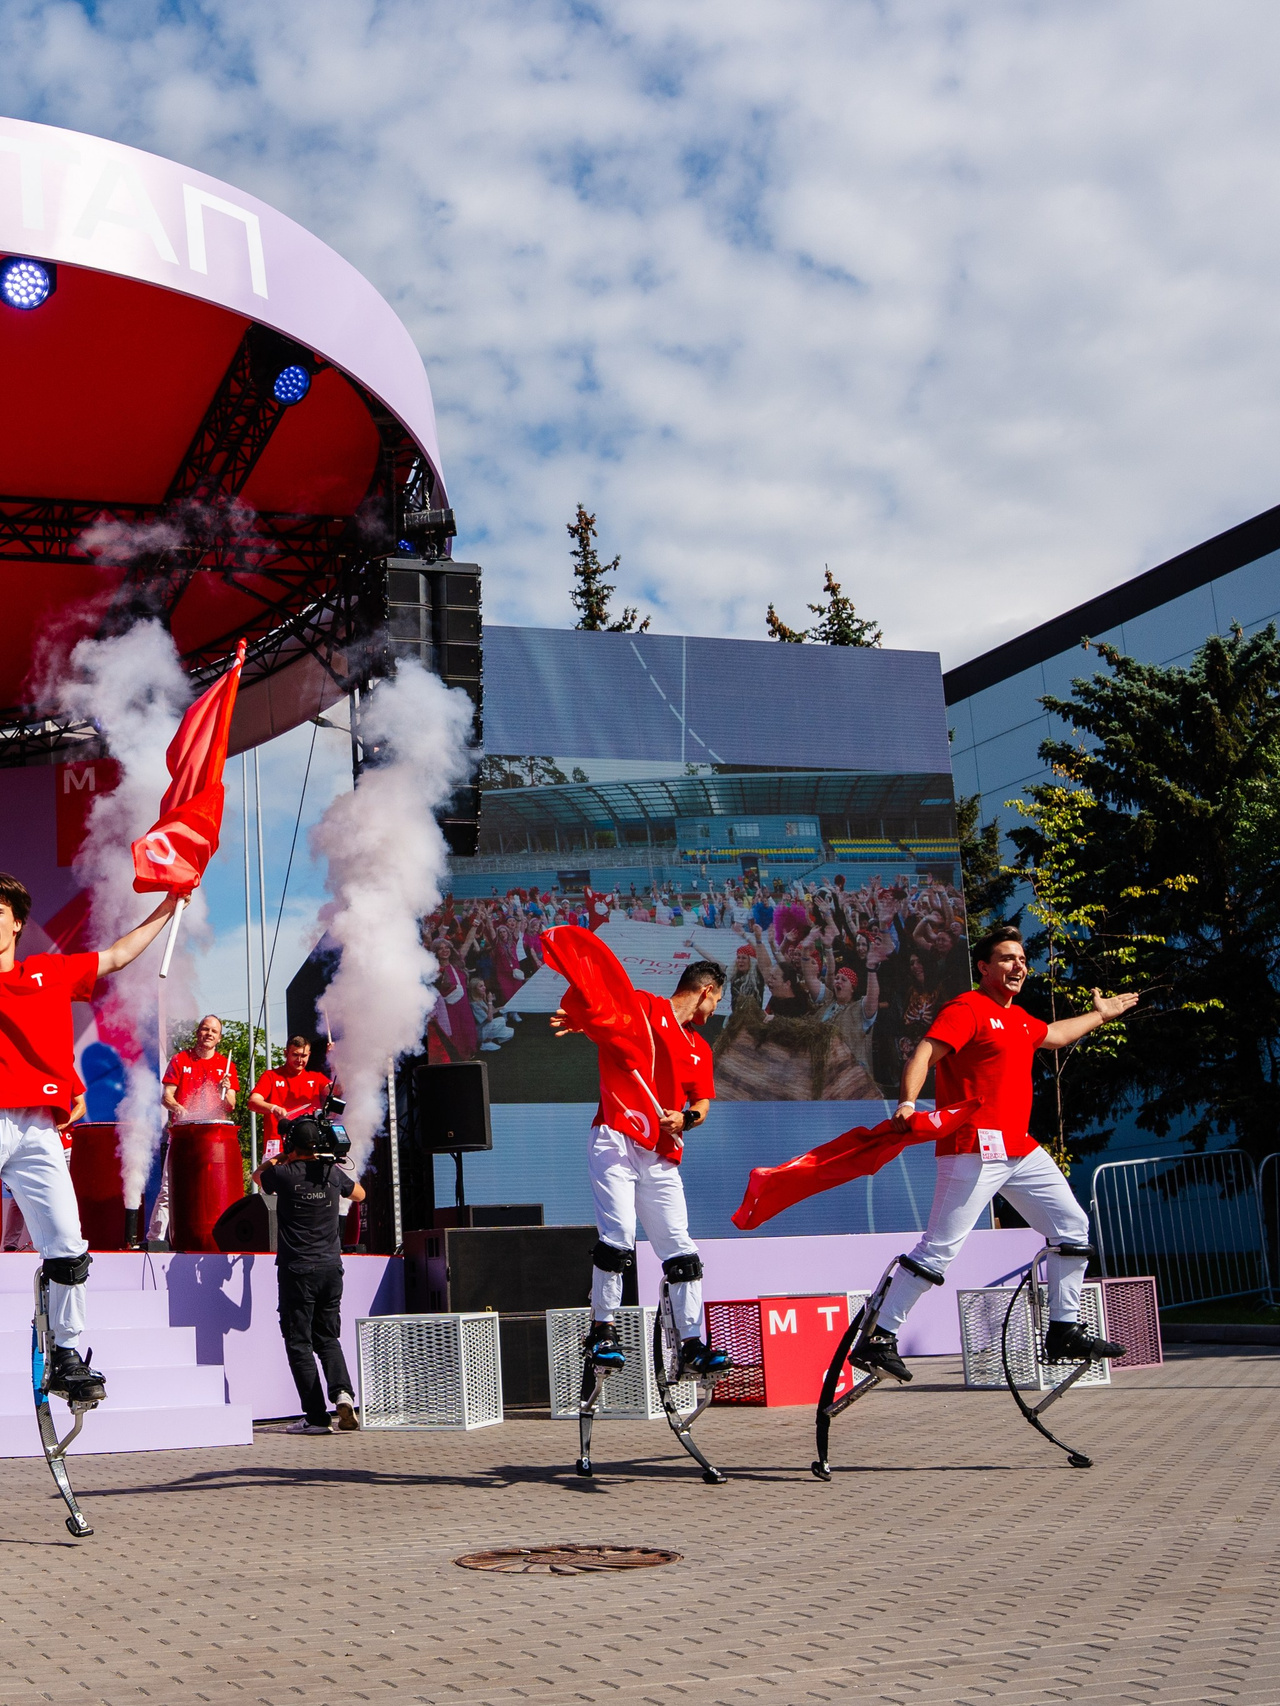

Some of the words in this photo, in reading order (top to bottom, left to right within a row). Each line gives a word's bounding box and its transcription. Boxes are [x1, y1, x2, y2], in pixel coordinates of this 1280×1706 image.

[31, 973, 43, 987] Т
[989, 1017, 1004, 1030] М
[42, 1083, 58, 1095] С
[768, 1308, 797, 1335] М
[817, 1306, 840, 1331] Т
